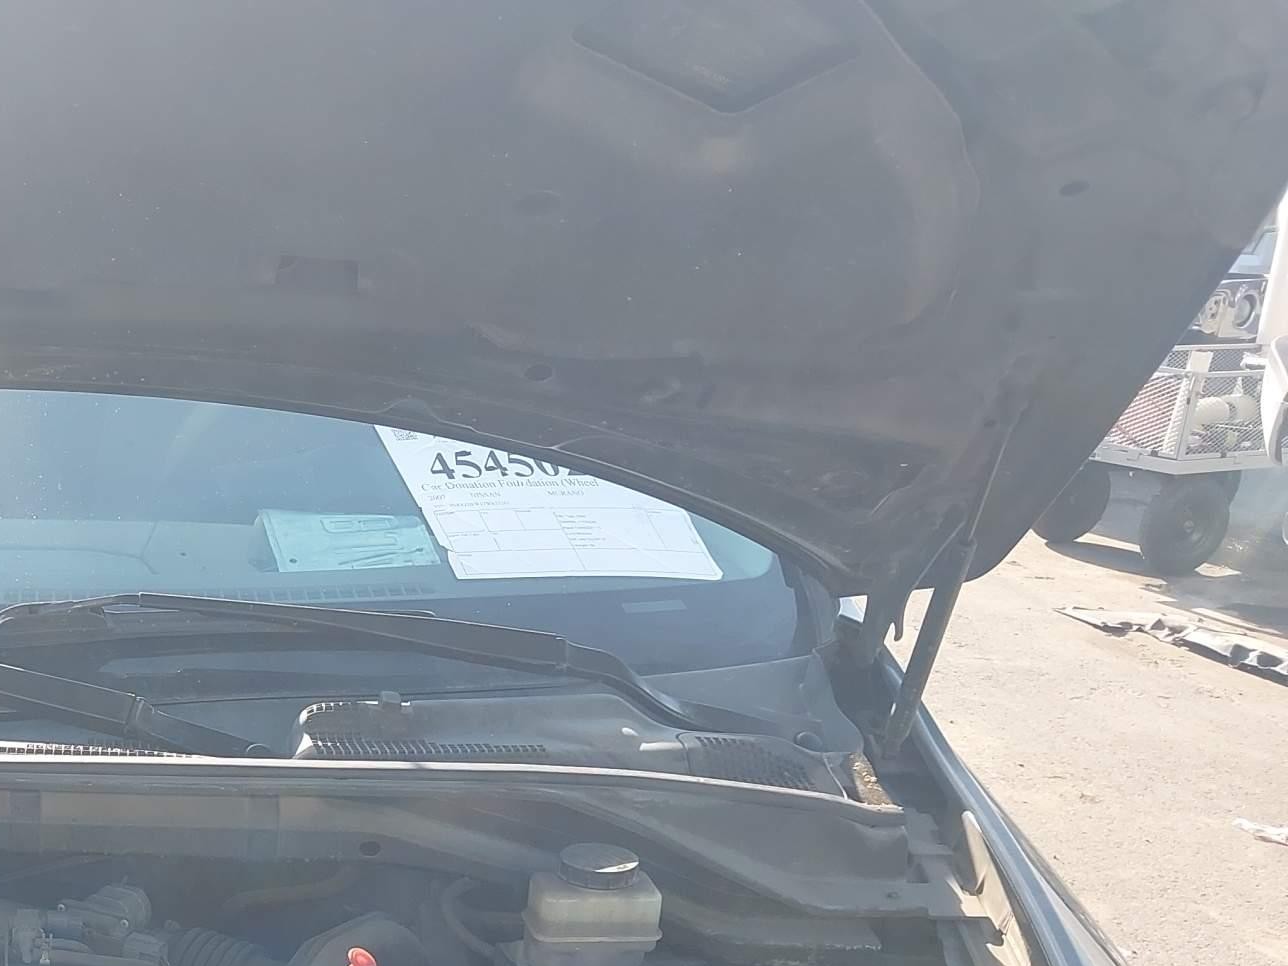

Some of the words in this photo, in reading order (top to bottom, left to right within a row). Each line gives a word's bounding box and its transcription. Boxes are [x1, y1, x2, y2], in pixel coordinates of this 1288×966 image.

[430, 450, 585, 480] 45450
[444, 480, 496, 490] Donation
[498, 478, 559, 489] Foundation
